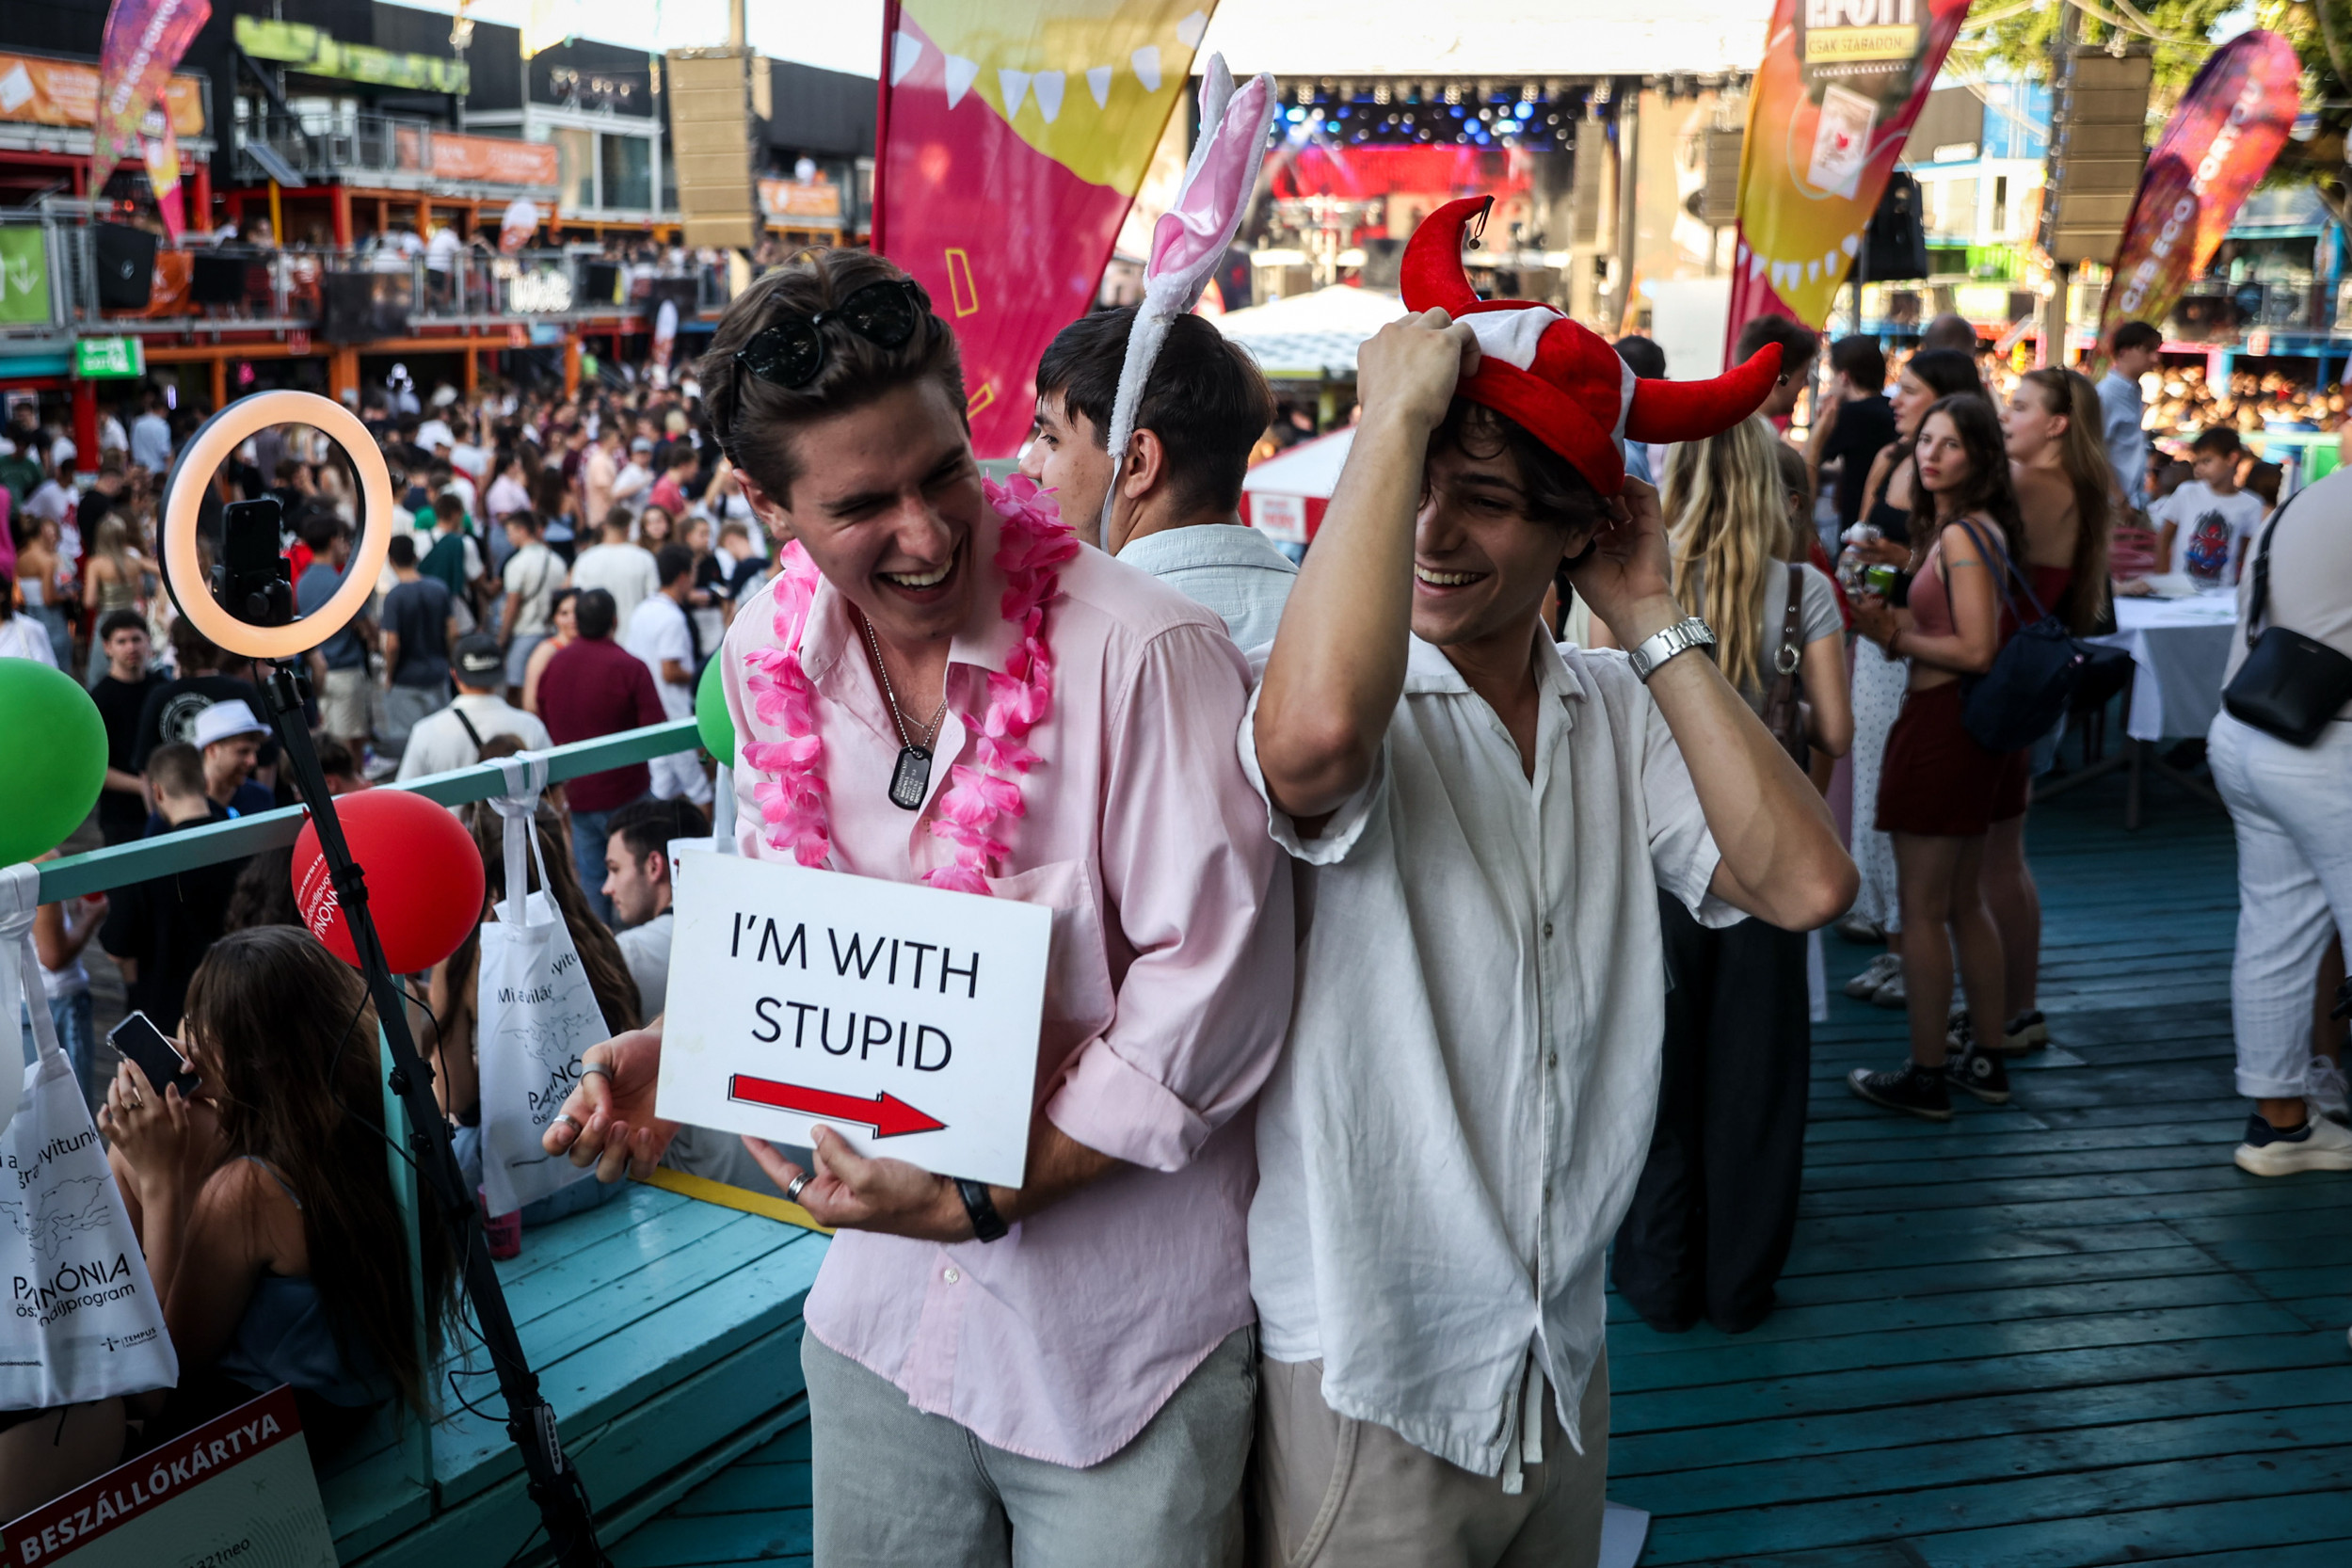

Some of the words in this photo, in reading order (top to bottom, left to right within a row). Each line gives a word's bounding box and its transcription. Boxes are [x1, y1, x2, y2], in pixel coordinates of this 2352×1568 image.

[2151, 195, 2196, 259] ECO
[827, 927, 980, 999] WITH
[751, 996, 952, 1073] STUPID
[124, 1327, 156, 1343] TEMPUS
[20, 1413, 281, 1565] BESZÁLLÓKÁRTYA
[189, 1537, 250, 1568] 321neo
